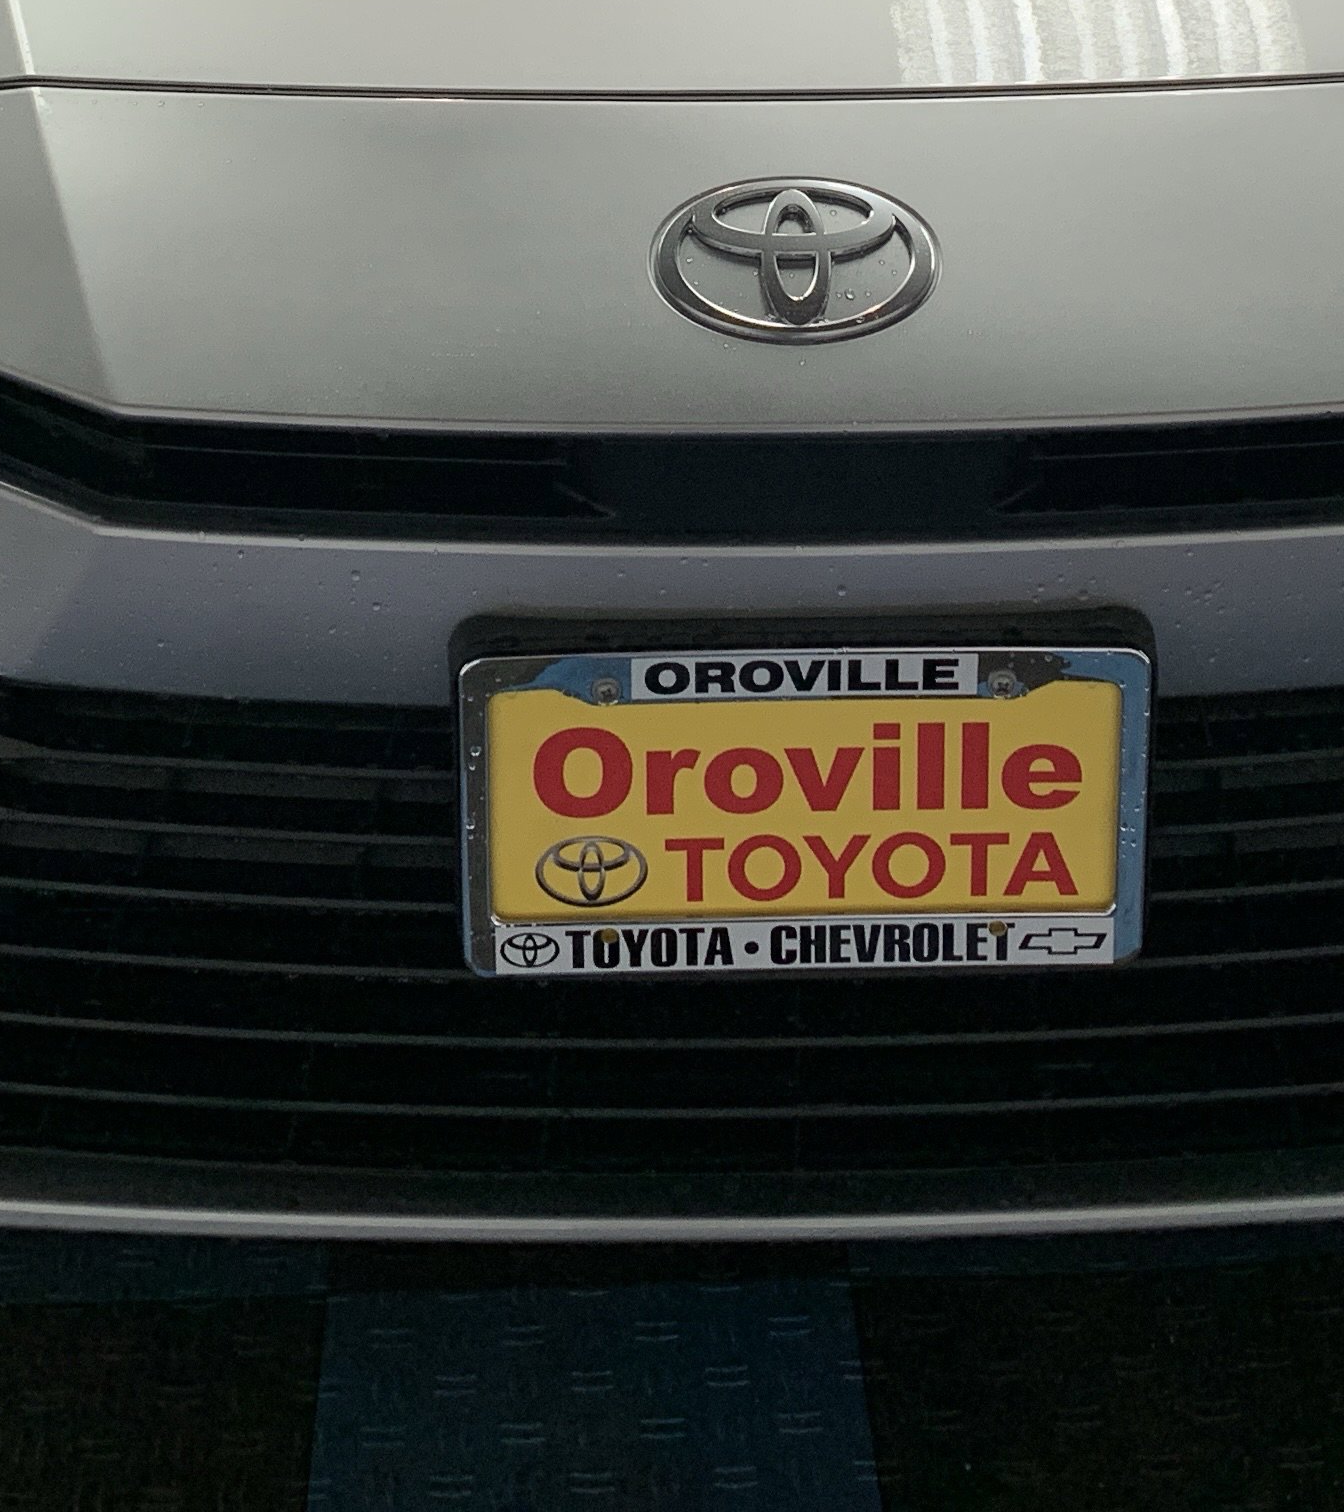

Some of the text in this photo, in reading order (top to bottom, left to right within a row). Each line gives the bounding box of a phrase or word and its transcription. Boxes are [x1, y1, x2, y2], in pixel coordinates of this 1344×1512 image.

[644, 657, 960, 696] OROVILLE
[532, 721, 1083, 819] Oroville
[664, 831, 1080, 903] TOYOTA
[565, 920, 1016, 969] TOYOTA CHEVROLET
